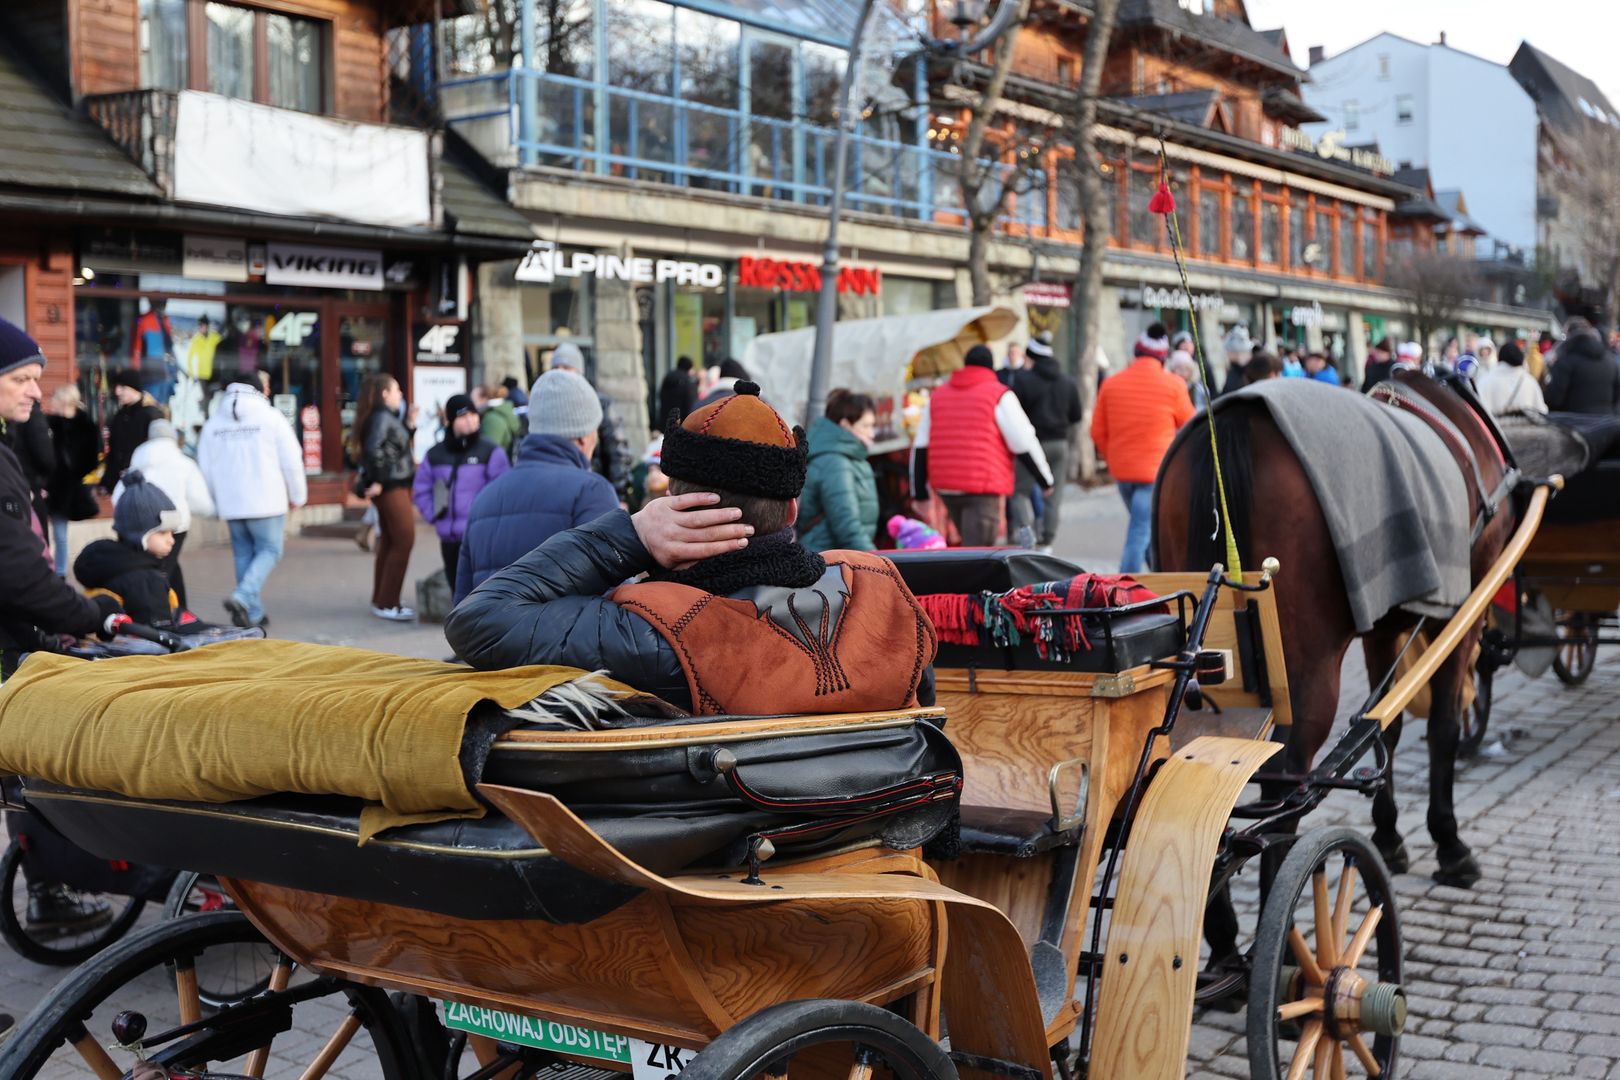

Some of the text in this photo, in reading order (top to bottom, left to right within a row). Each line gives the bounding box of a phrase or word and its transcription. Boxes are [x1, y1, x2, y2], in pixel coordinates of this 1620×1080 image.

[272, 252, 379, 277] VIKING
[656, 258, 722, 288] PRO
[738, 256, 880, 296] ROSSMNN
[269, 311, 319, 346] 4F
[418, 324, 460, 354] 4F
[448, 1002, 544, 1041] ZACHOWAJ
